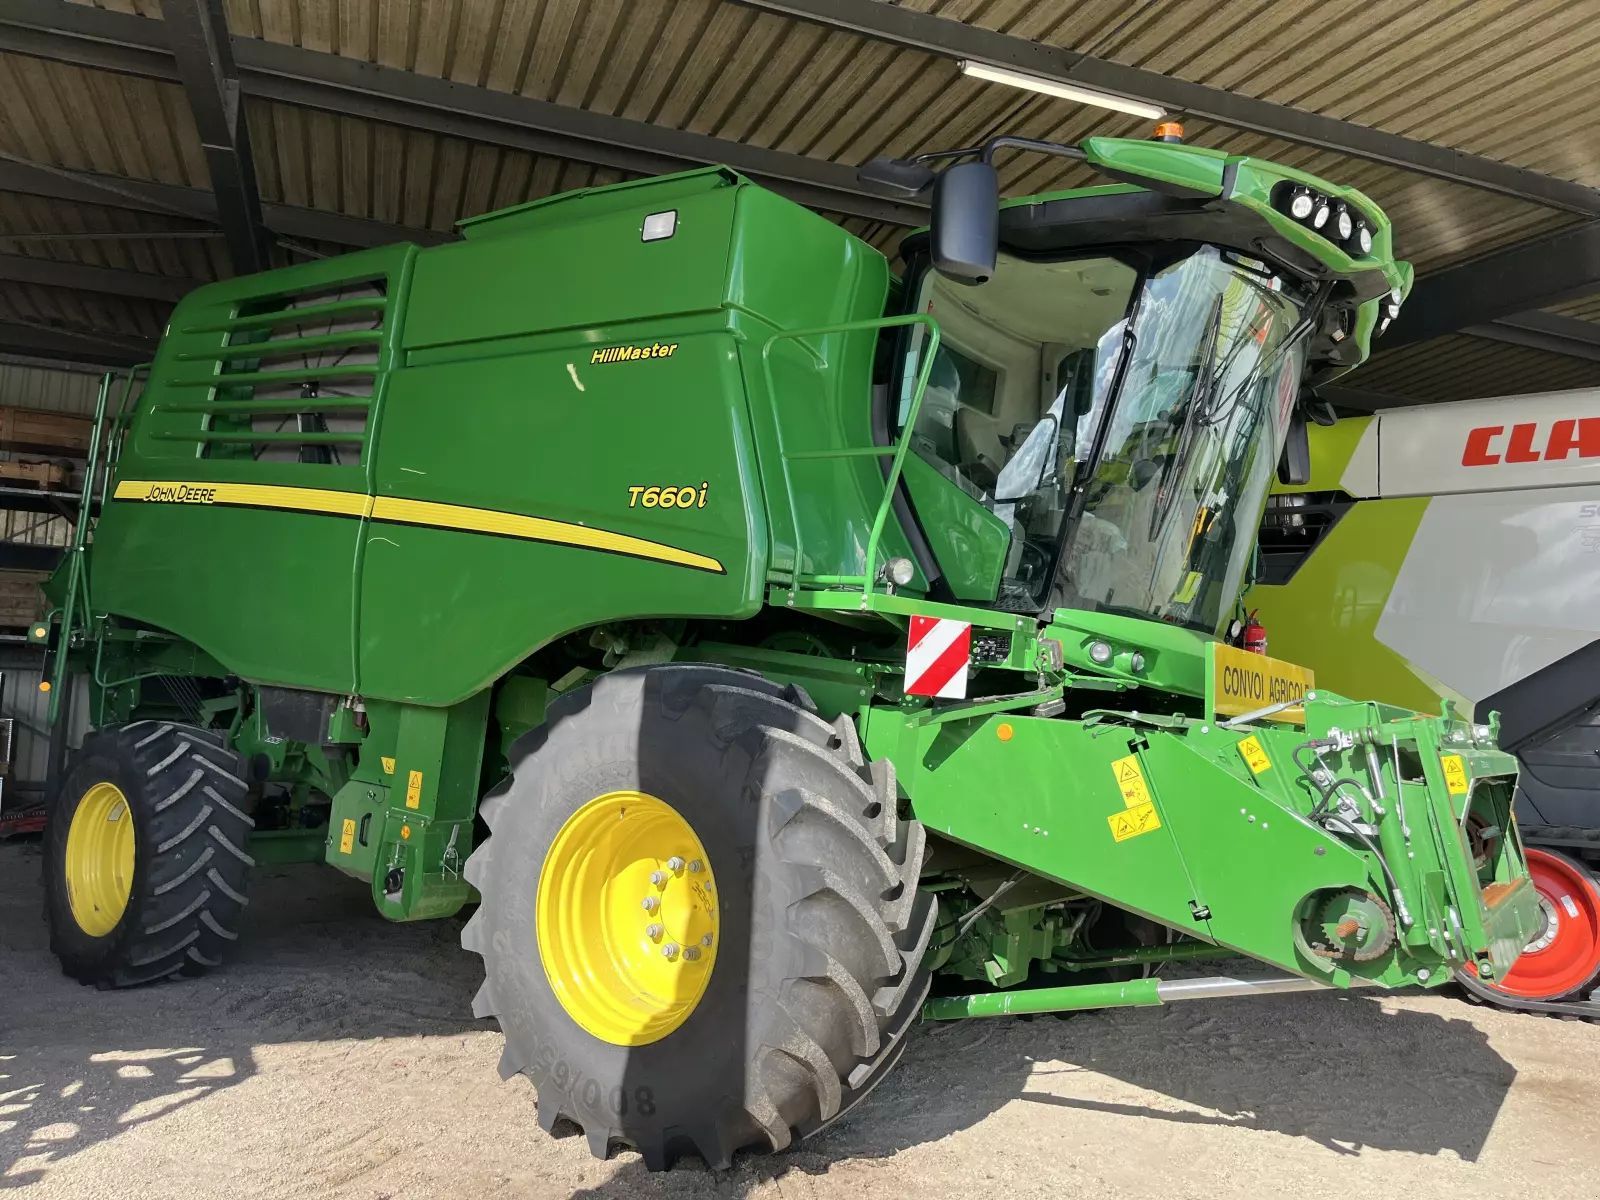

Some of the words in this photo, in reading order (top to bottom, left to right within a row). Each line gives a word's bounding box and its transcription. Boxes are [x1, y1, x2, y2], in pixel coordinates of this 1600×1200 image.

[590, 342, 679, 364] HillMaster
[145, 484, 177, 500] JOHN
[177, 484, 217, 502] DEERE
[628, 481, 709, 509] T660i
[1223, 665, 1264, 700] CONVOI
[1269, 676, 1310, 706] AGRICOL
